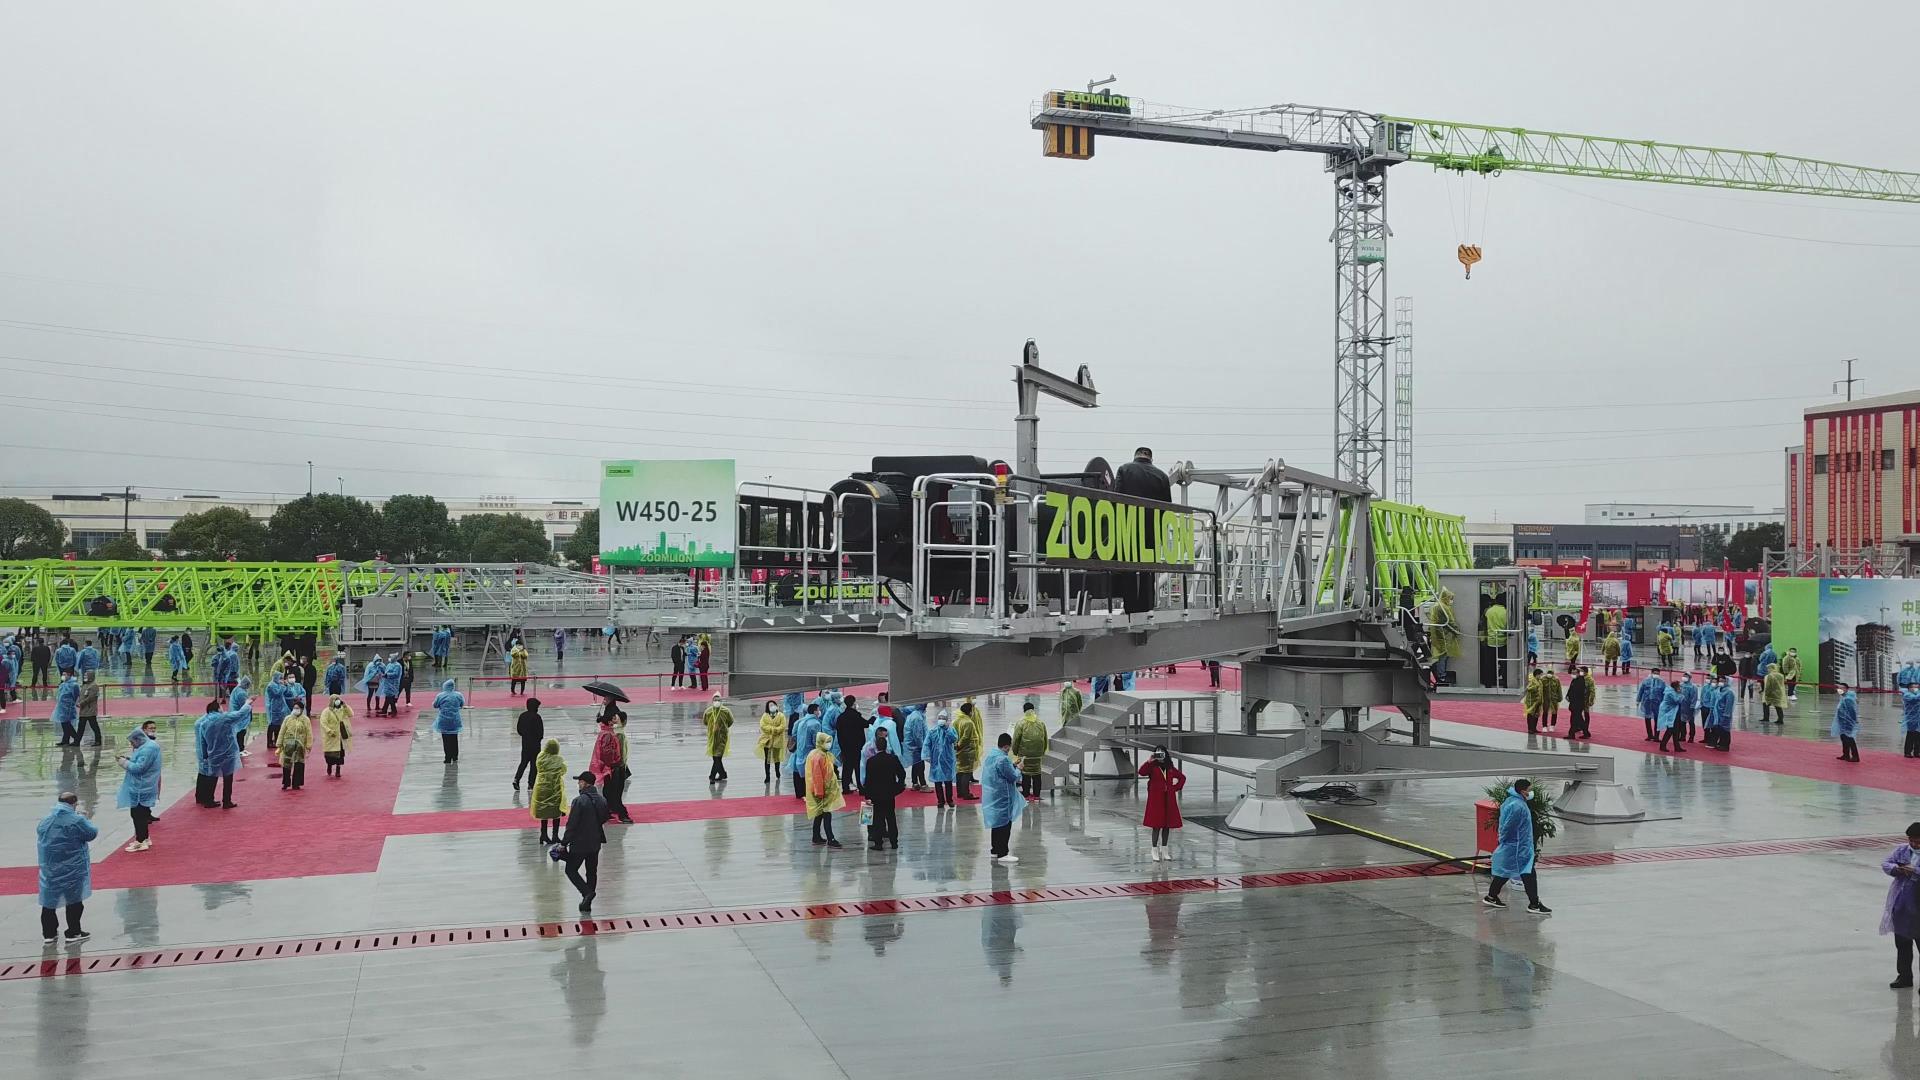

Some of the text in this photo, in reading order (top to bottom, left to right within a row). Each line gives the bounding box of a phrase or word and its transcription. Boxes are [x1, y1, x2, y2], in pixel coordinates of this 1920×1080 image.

[1063, 91, 1130, 108] ZOOMLION
[616, 500, 718, 522] W450-25
[1046, 491, 1195, 564] ZOOMLION
[640, 553, 695, 562] ZOOMLION
